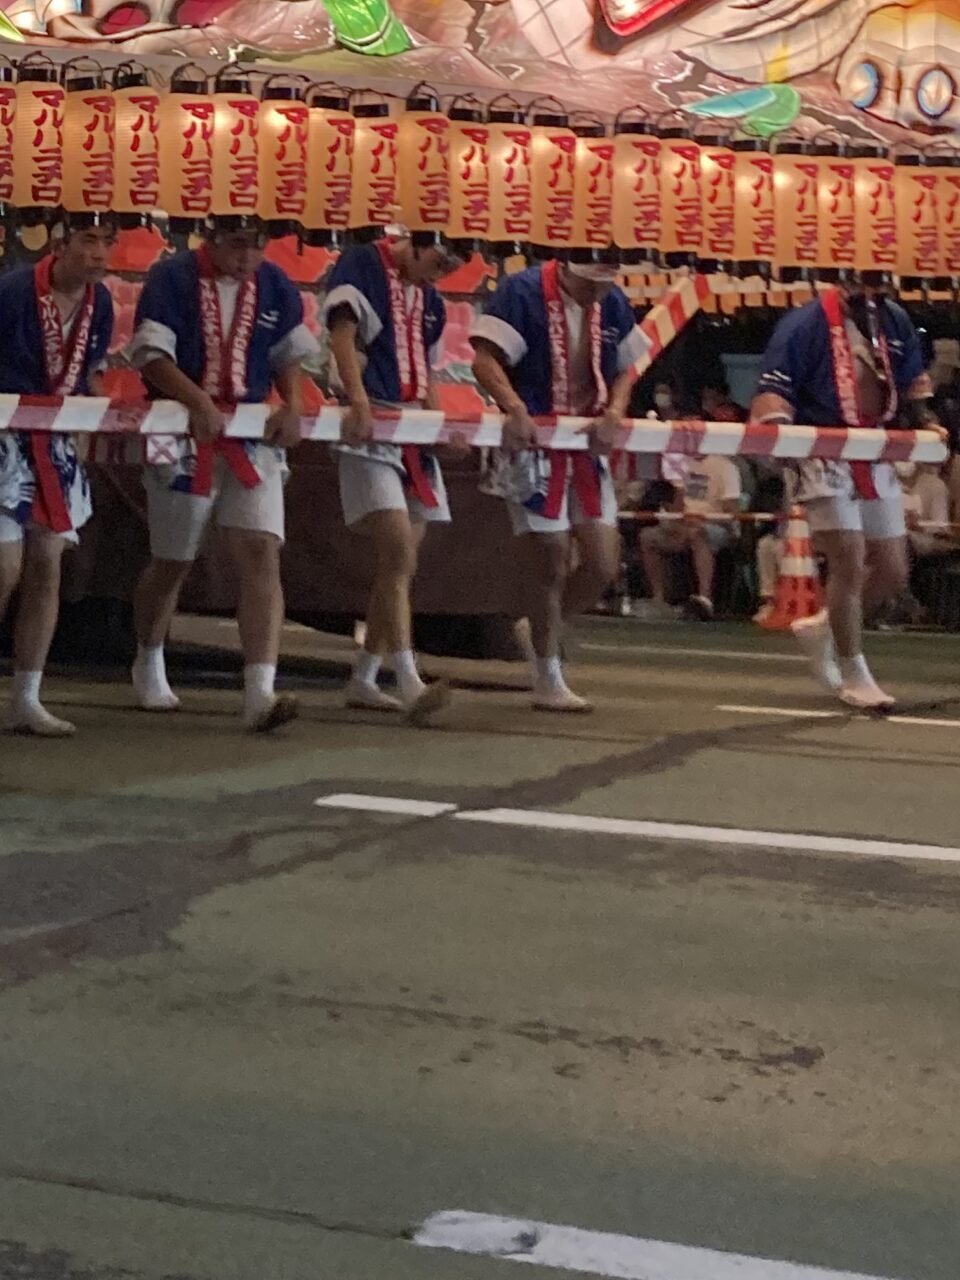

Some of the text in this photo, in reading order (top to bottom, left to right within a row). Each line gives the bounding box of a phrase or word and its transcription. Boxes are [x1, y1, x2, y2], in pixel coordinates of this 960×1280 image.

[32, 89, 65, 203] マルハニチロ
[81, 95, 116, 211] マルハニチロ
[128, 96, 161, 207] マルハニチロ
[180, 101, 215, 214] マルハニチロ
[227, 99, 261, 208] マルハニチロ
[275, 106, 310, 215] マルハニチロ
[323, 117, 356, 226] マルハニチロ
[367, 123, 400, 226] マルハニチロ
[416, 117, 451, 225] マルハニチロ
[459, 127, 492, 234] マルハニチロ
[502, 130, 534, 235] マルハニチロ
[544, 135, 576, 243] マルハニチロ
[583, 144, 617, 246] マルハニチロ
[630, 140, 664, 245] マルハニチロ
[669, 144, 704, 249] マルハニチロ
[706, 152, 738, 255] マルハニチロ
[748, 158, 778, 257] マルハニチロ
[793, 163, 821, 263] マルハニチロ
[827, 164, 858, 265] マルハニチロ
[867, 166, 897, 265] マルハニチロ
[912, 174, 940, 273] マルハニチロ
